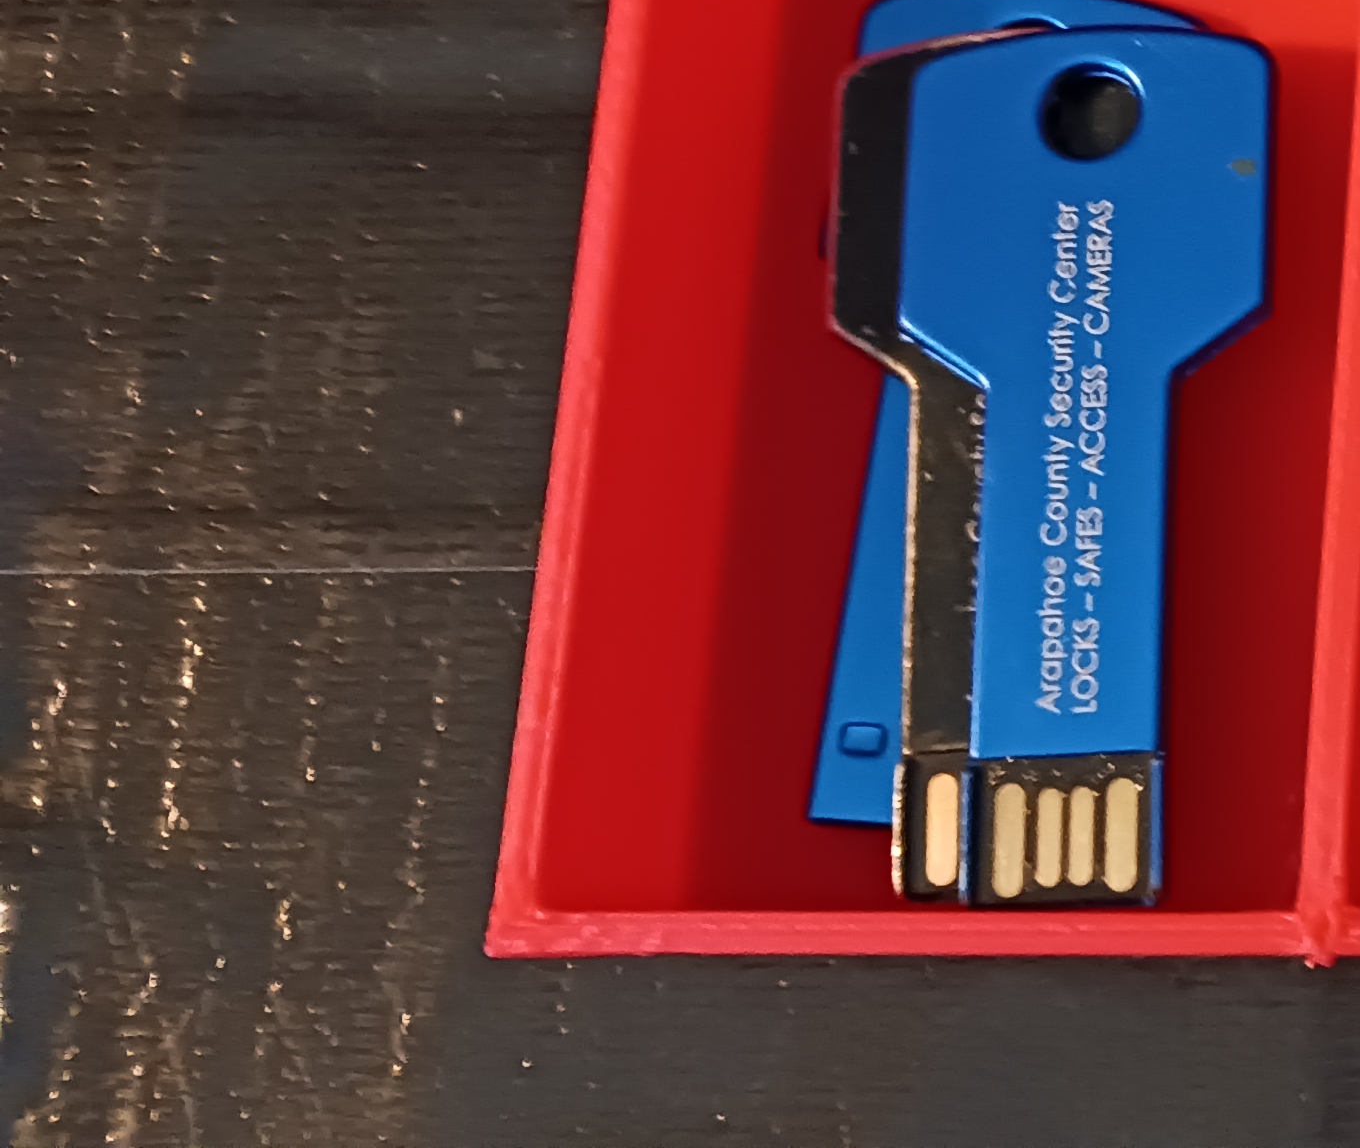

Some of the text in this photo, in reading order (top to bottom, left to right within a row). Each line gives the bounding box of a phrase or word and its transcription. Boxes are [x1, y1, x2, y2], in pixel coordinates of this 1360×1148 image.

[1082, 199, 1115, 335] CAMERAS
[1035, 201, 1081, 714] Arapahoe County Security Center
[1078, 363, 1109, 477] ACCESS
[1073, 506, 1104, 587] SAFES
[1069, 616, 1100, 713] LOCKS
